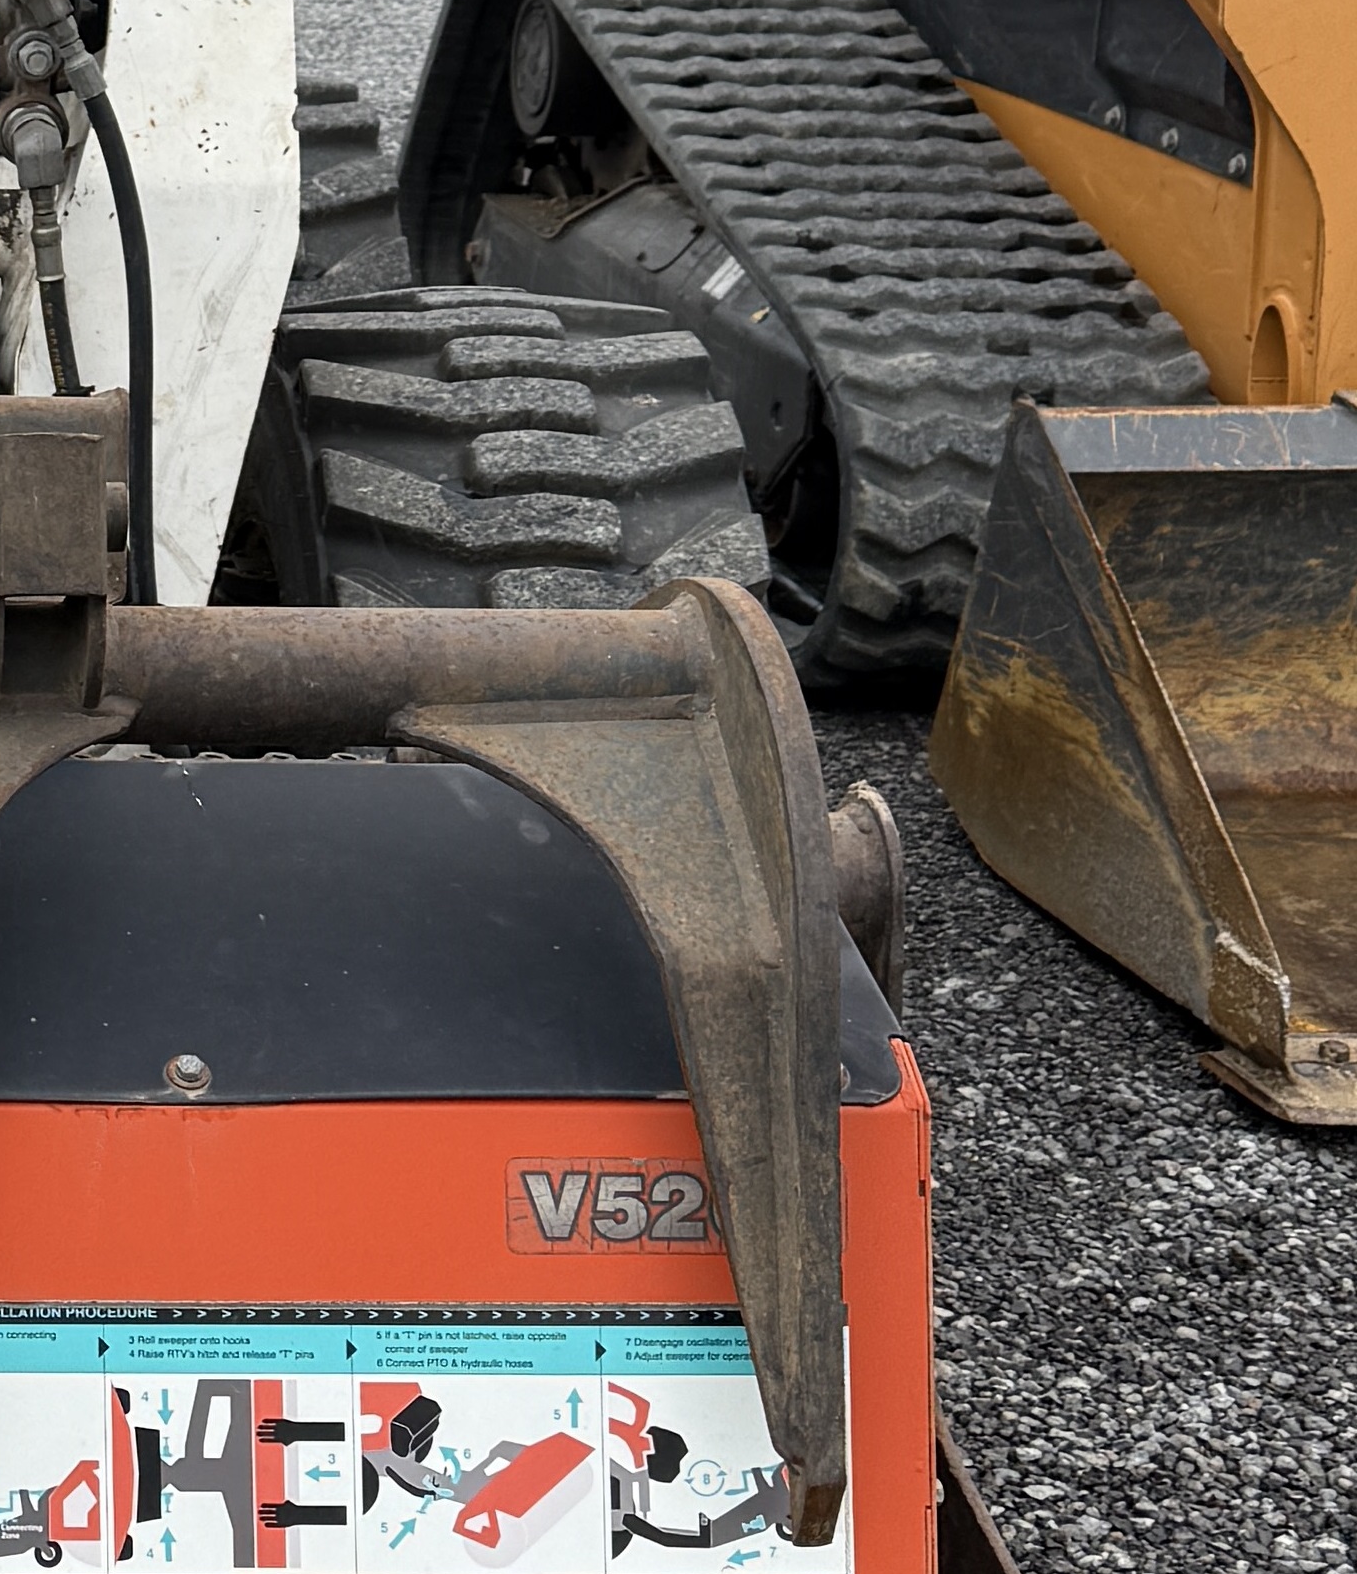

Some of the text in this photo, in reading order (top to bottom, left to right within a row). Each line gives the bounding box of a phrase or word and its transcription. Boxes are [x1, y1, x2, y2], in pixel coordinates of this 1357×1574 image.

[520, 1171, 723, 1242] V52
[65, 1307, 158, 1319] PROCEDURE
[6, 1330, 56, 1341] connecting
[129, 1337, 134, 1345] 3
[137, 1336, 155, 1345] Roll
[223, 1336, 250, 1345] hooks
[418, 1331, 432, 1341] pin
[527, 1332, 566, 1341] opposite
[418, 1345, 427, 1353] of
[625, 1338, 748, 1349] 7 Disengage oscillation loc
[129, 1350, 135, 1358] 4
[137, 1350, 165, 1359] Raise
[223, 1350, 239, 1359] and
[242, 1350, 276, 1359] release
[295, 1351, 314, 1361] pins
[634, 1352, 662, 1361] Adjust
[707, 1352, 720, 1360] for
[385, 1359, 425, 1368] Connect
[427, 1359, 448, 1368] PTO
[451, 1359, 458, 1368] &
[461, 1359, 503, 1369] hydraulic
[505, 1360, 533, 1368] hoses
[141, 1391, 149, 1402] 4
[553, 1409, 561, 1420] 5
[328, 1453, 336, 1464] 3
[463, 1448, 471, 1459] 6
[381, 1522, 388, 1533] 5
[146, 1548, 154, 1558] 4
[770, 1546, 777, 1557] 7
